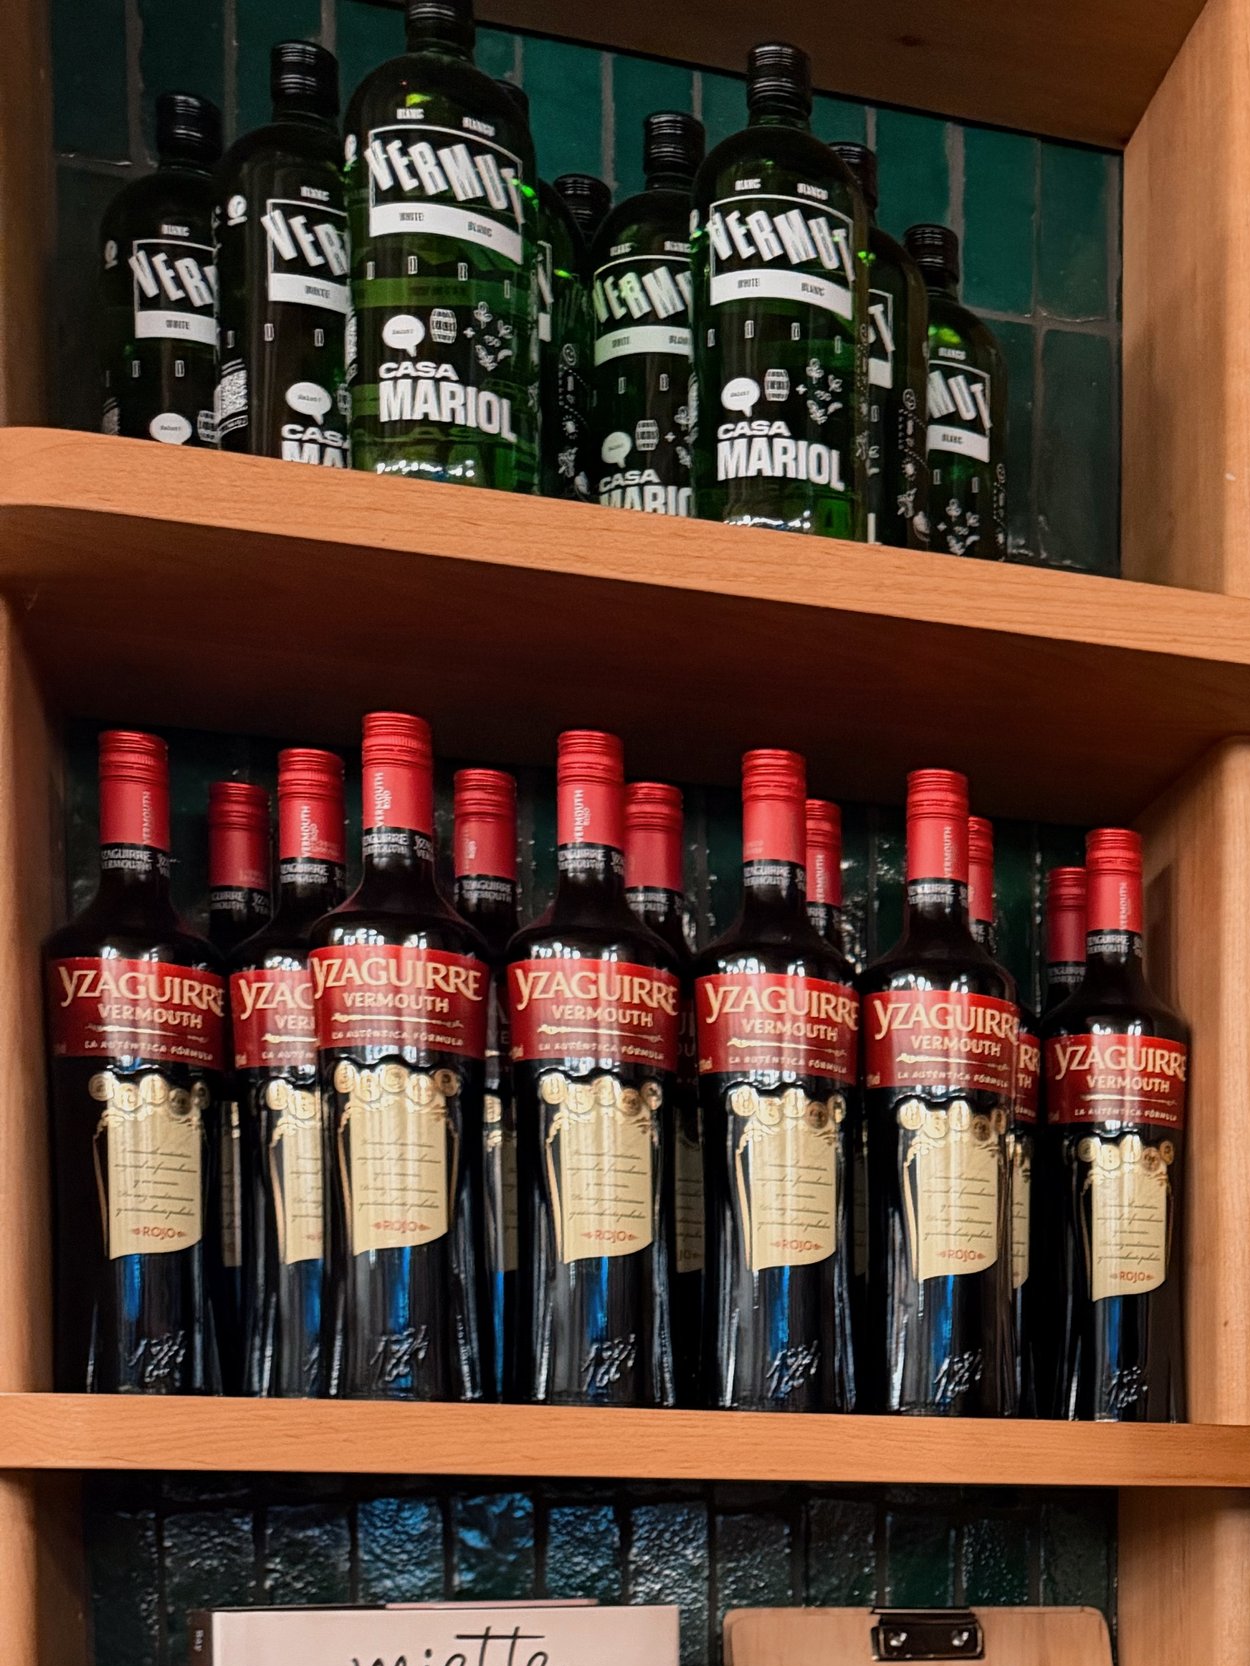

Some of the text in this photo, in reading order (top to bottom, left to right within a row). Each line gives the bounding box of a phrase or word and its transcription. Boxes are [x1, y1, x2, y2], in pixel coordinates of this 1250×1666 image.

[364, 140, 526, 224] VERMUT
[707, 209, 855, 282] VERMUT
[379, 361, 459, 381] CASA
[379, 379, 517, 443] MARIOL
[717, 420, 791, 439] CASA
[717, 436, 844, 491] MARIOL
[598, 469, 661, 492] CASA
[342, 992, 449, 1012] VERMOUTH
[97, 1003, 202, 1028] VERMOUTH
[552, 1004, 653, 1027] VERMOUTH
[741, 1018, 838, 1042] VERMOUTH
[911, 1035, 1001, 1057] VERMOUTH
[1086, 1075, 1170, 1093] VERMOUTH
[143, 1226, 175, 1240] ROJO
[383, 1220, 417, 1233] ROJO
[594, 1230, 626, 1243] ROJO
[782, 1239, 813, 1252] ROJO
[947, 1250, 976, 1261] ROJO
[1119, 1272, 1145, 1282] ROJO
